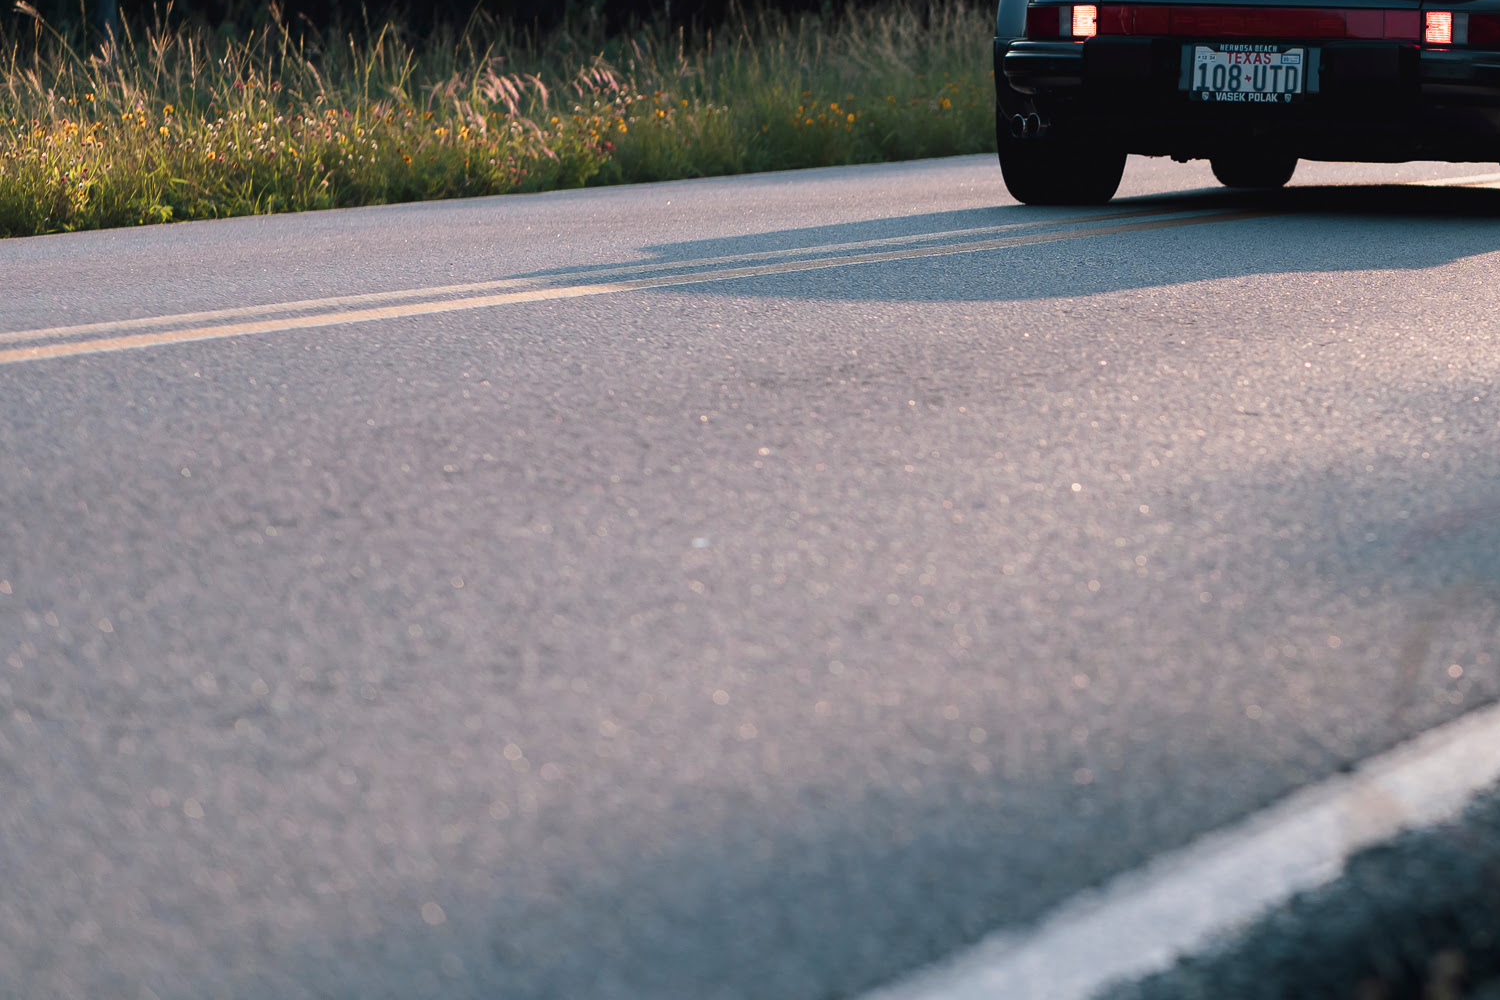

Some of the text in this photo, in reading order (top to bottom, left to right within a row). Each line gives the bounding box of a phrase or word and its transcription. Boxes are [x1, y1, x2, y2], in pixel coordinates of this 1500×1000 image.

[1220, 44, 1278, 52] HERMOSA BEACH
[1227, 52, 1272, 64] TEXAS
[1196, 63, 1298, 93] 108 UTD
[1215, 92, 1278, 102] VASEK POLAK
